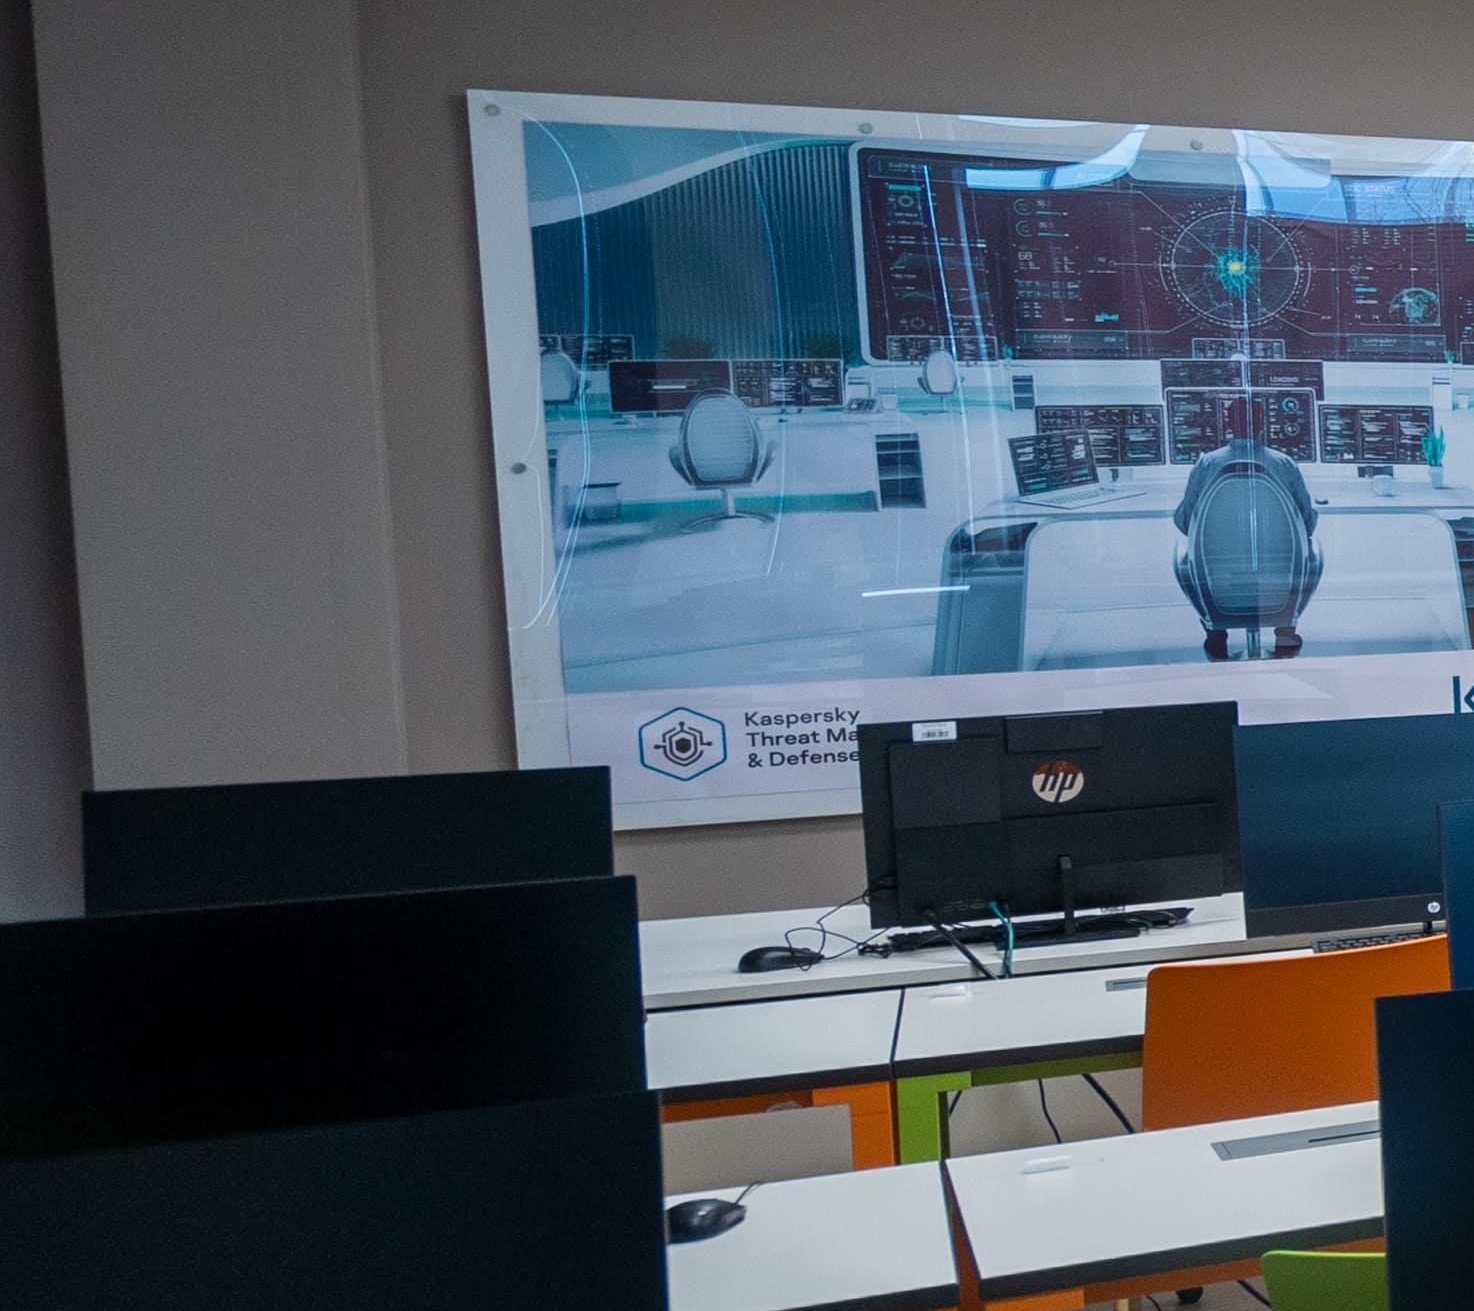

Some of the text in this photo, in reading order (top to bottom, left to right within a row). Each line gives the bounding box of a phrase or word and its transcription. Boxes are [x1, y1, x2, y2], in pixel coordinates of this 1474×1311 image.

[744, 706, 860, 728] Kaspersky
[746, 730, 820, 747] Threat
[748, 749, 860, 768] & Defense
